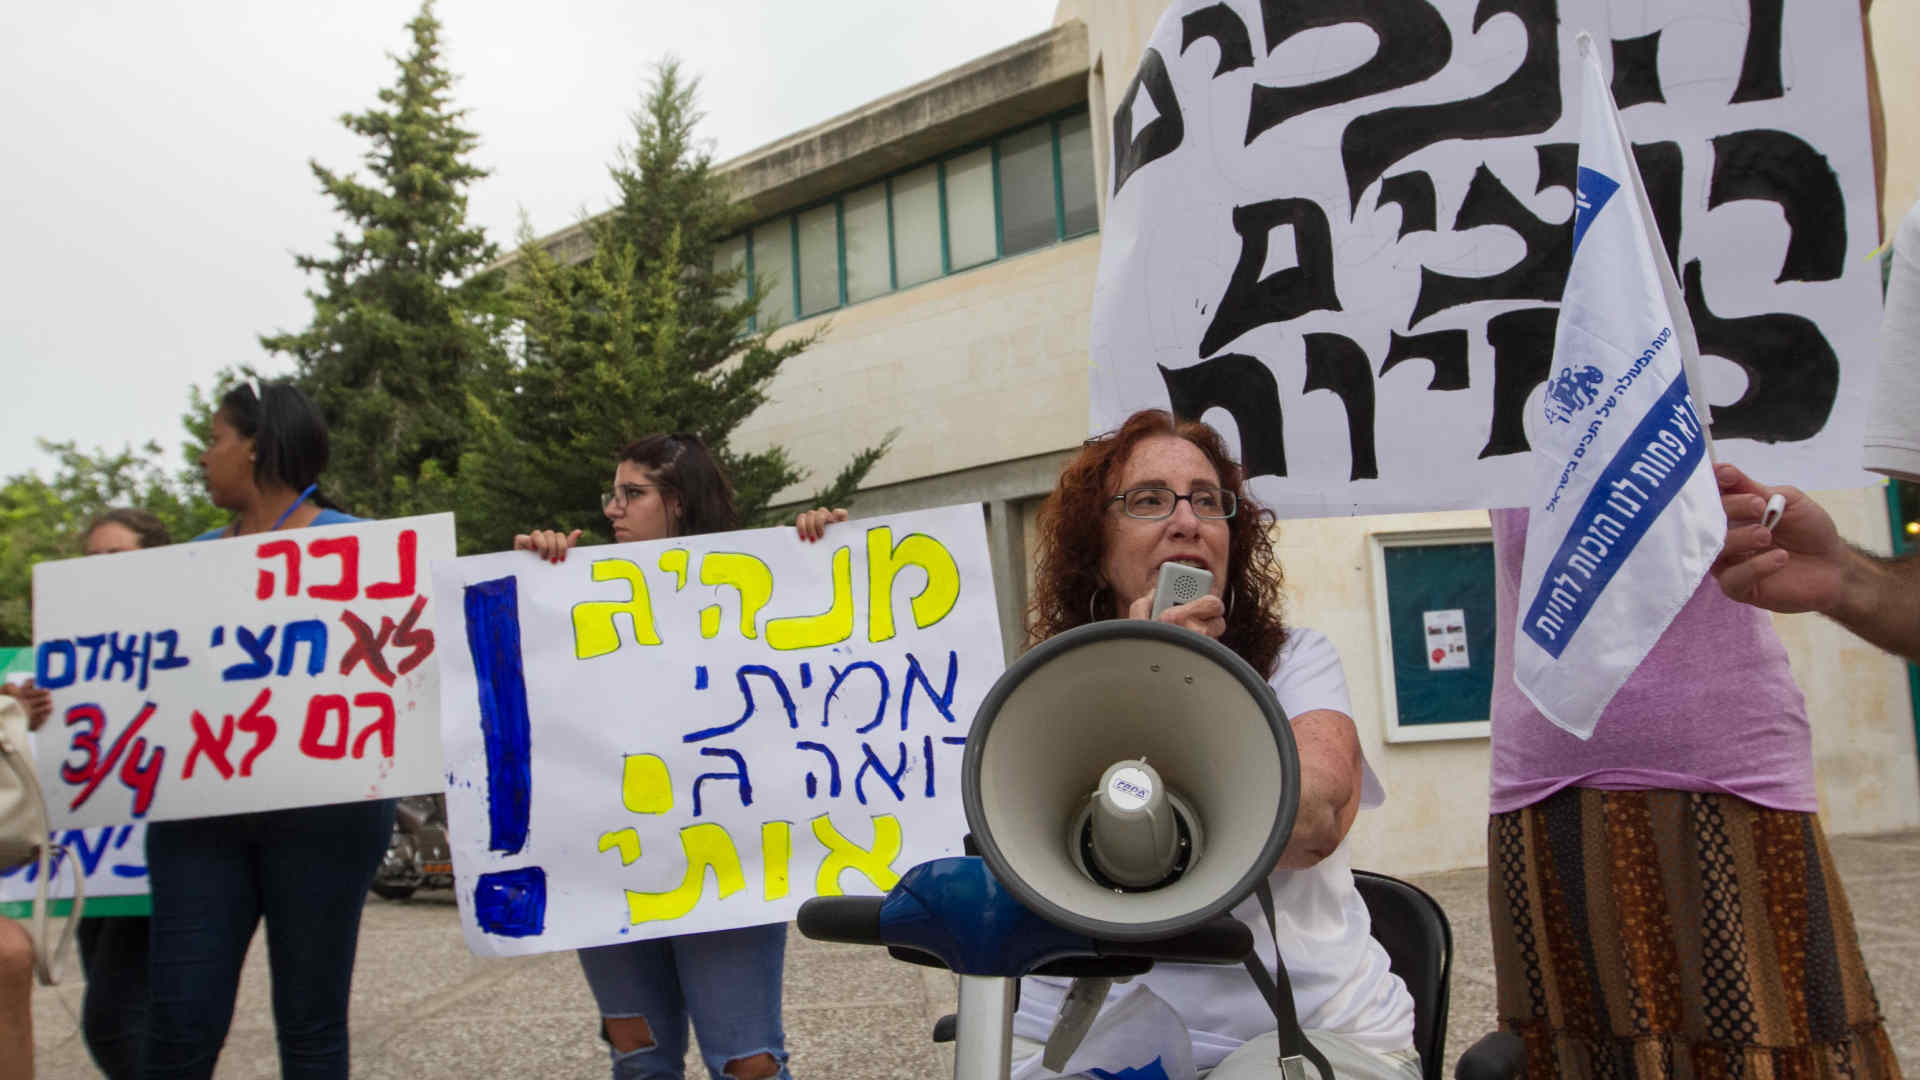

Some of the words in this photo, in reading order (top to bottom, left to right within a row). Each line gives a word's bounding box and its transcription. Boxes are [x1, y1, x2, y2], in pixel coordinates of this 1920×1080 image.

[1573, 420, 1603, 459] הנכים
[1595, 395, 1617, 418] של
[1545, 460, 1578, 513] בישראל
[1630, 429, 1687, 489] פחות
[1605, 478, 1649, 519] לנו
[255, 529, 418, 601] נכה
[1568, 513, 1626, 580] הזכות
[571, 525, 961, 660] מנהיג
[1535, 573, 1583, 641] לחיות
[209, 619, 329, 683] חצי
[338, 594, 436, 688] לא
[299, 691, 397, 761] גם
[682, 650, 960, 743] אמיתי
[60, 701, 166, 819] 3/4
[181, 687, 278, 781] לא
[796, 735, 968, 806] ואה
[599, 812, 903, 925] אותי
